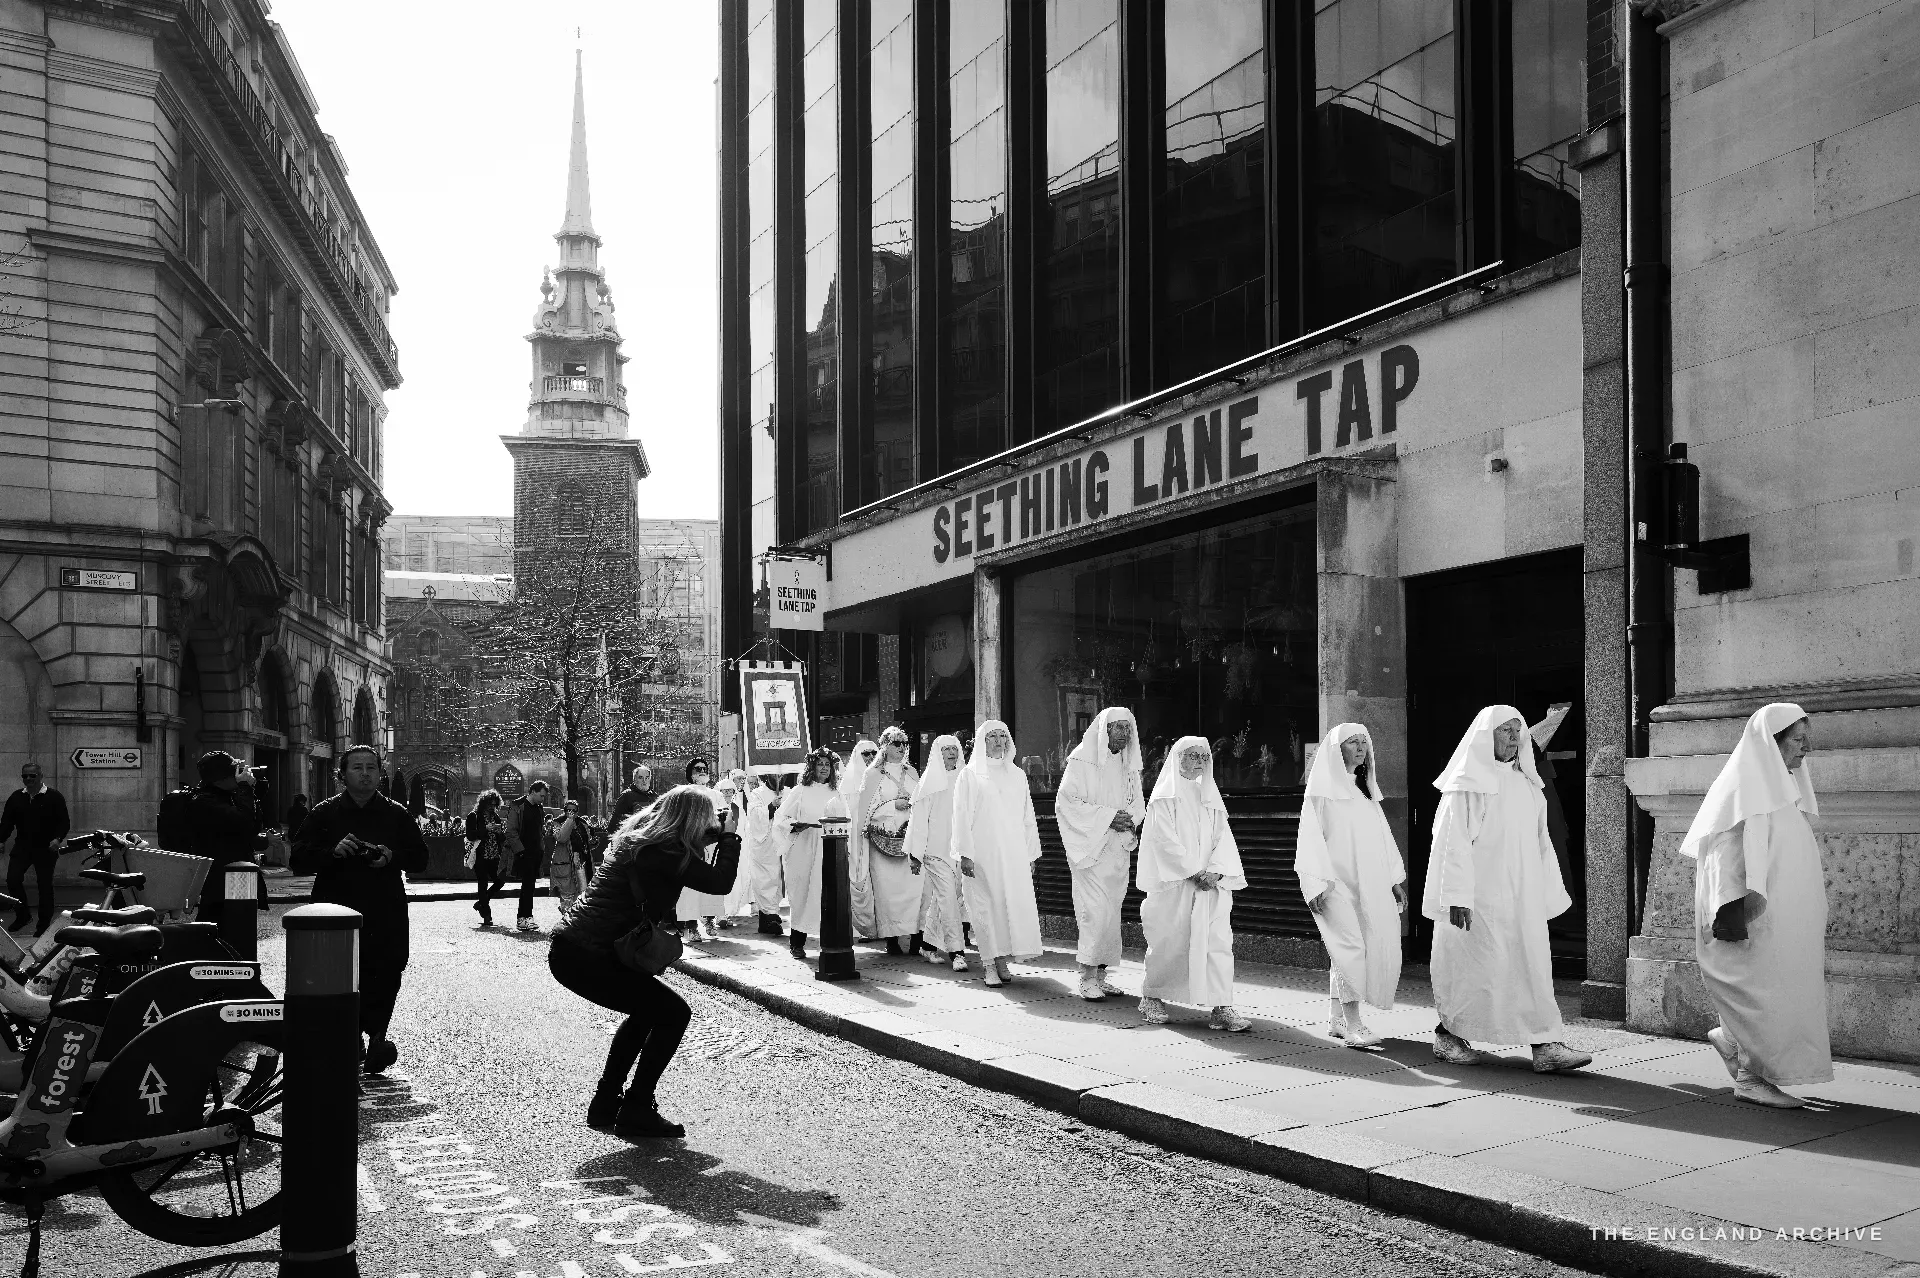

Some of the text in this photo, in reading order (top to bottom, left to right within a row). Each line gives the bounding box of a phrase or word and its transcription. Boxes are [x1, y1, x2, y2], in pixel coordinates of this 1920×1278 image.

[933, 344, 1420, 565] SEETHING LANE TAP
[777, 586, 817, 600] SEETHING
[778, 600, 816, 613] LANE TAP
[236, 1008, 281, 1017] 30 MINS
[40, 1031, 85, 1107] forest
